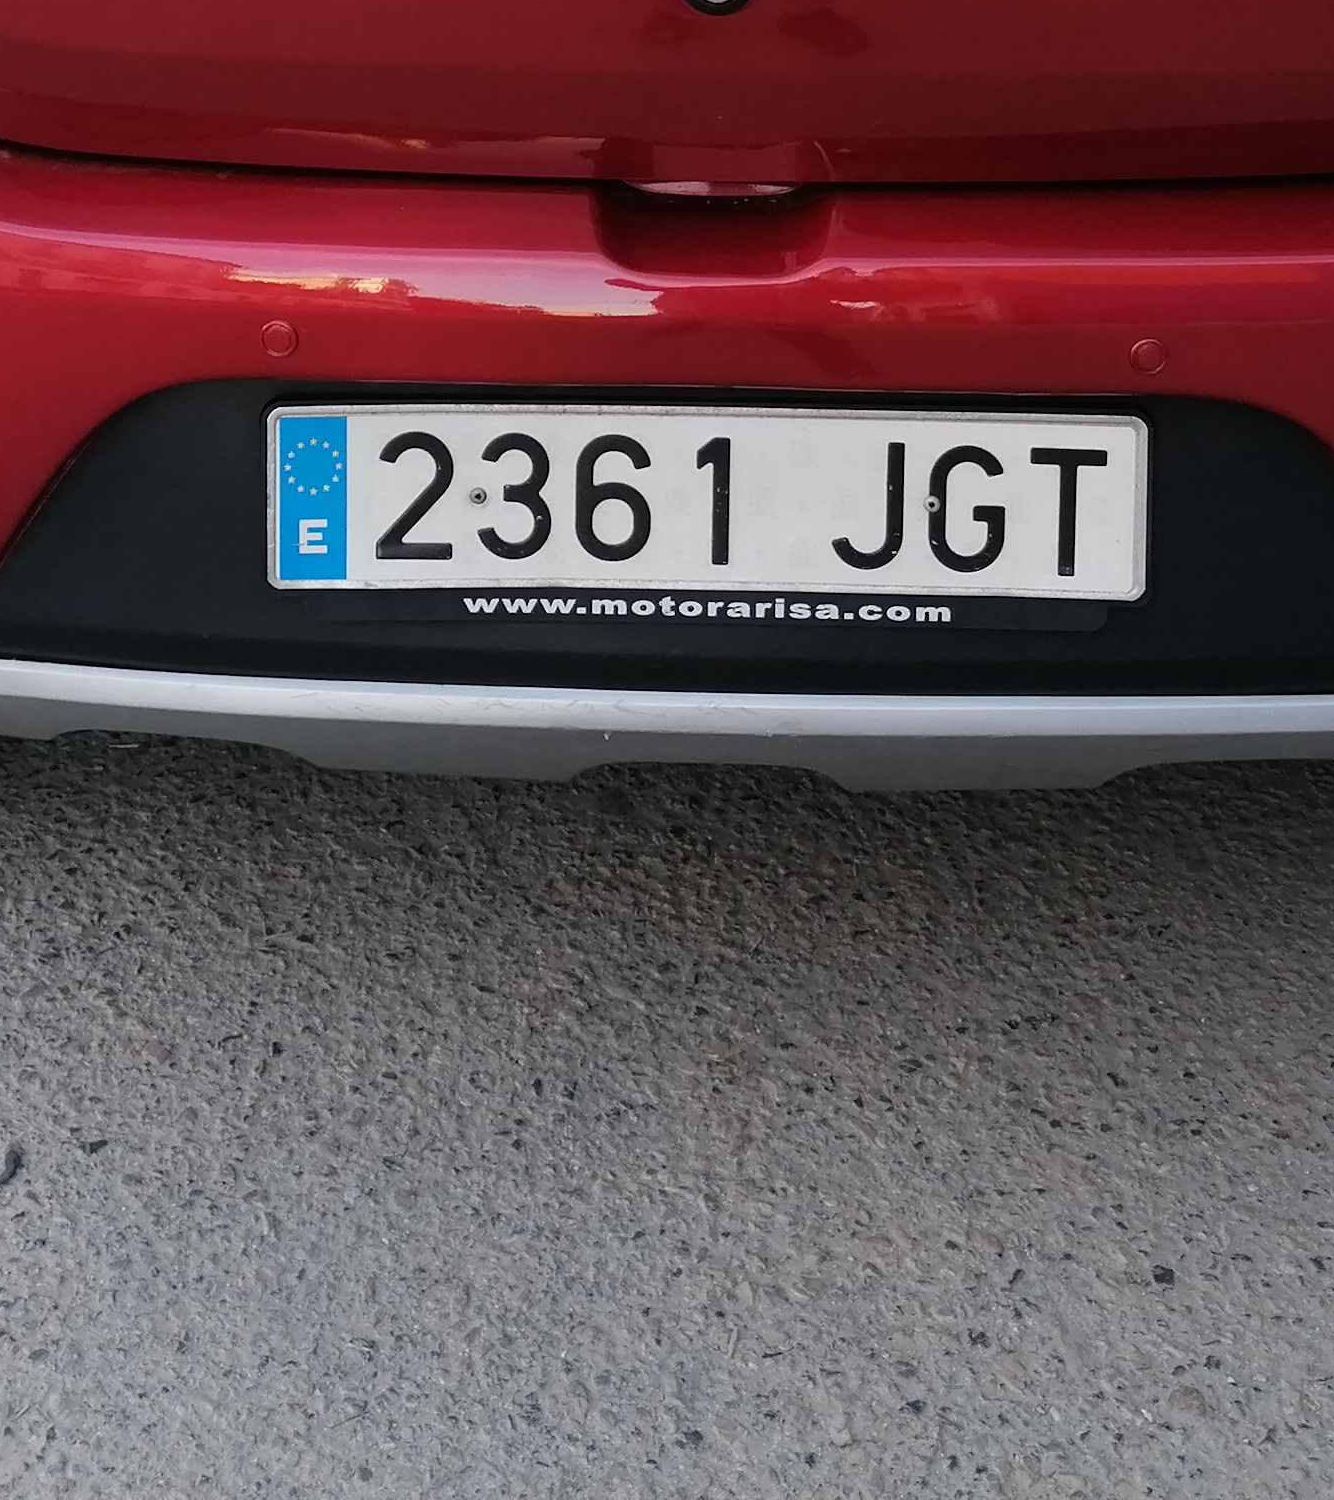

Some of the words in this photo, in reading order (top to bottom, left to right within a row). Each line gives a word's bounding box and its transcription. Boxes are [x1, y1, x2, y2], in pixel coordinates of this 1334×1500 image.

[374, 430, 732, 567] 2361
[830, 441, 1109, 578] JGT
[298, 518, 328, 554] E
[463, 595, 953, 623] www.motorarisa.com
